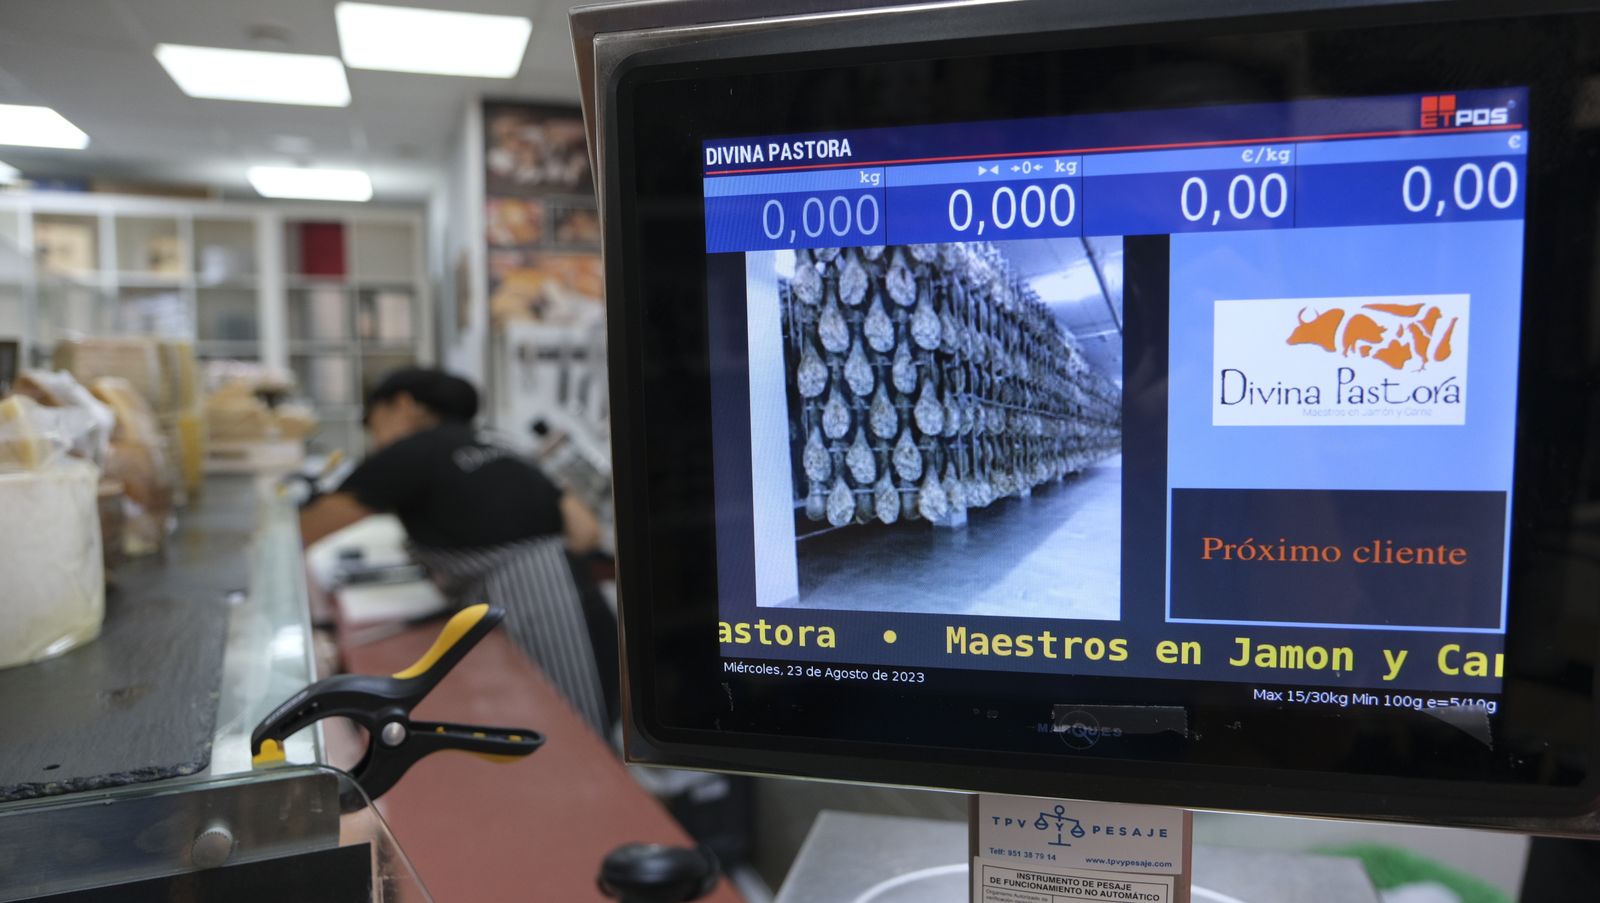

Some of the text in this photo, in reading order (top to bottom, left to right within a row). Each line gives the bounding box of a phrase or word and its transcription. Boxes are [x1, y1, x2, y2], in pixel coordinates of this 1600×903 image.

[1421, 107, 1508, 128] ETPOS
[706, 138, 852, 165] DIVINA PASTORA
[1508, 134, 1521, 149] €
[1241, 146, 1291, 165] €/kg
[860, 170, 881, 186] kg
[1055, 159, 1078, 176] kg
[1180, 172, 1288, 226] 0,00
[1402, 161, 1518, 217] 0,00
[762, 194, 879, 244] 0,000
[948, 183, 1076, 236] 0,000
[1220, 368, 1321, 405] Divina
[1201, 537, 1467, 565] Próximo cliente
[719, 618, 836, 649] astora
[946, 626, 1128, 662] Maestros
[1156, 639, 1201, 665] en
[1229, 637, 1353, 672] Jamon
[1382, 648, 1408, 681] y
[724, 661, 925, 683] Miércoles, 23 de Agosto de 2023
[1253, 688, 1283, 702] Max
[1287, 690, 1348, 707] 15/30kg
[1352, 692, 1378, 706] Min
[1384, 695, 1422, 711] 100g
[992, 816, 1026, 829] TPV
[1092, 825, 1168, 838] PESAJE
[1086, 857, 1172, 868] www.tpvypesaje.com
[990, 876, 1160, 901] DE FUNCIONAMIENTO NO AUTOMÁTICO
[1016, 872, 1132, 891] INSTRUMENTO DE PESAJE
